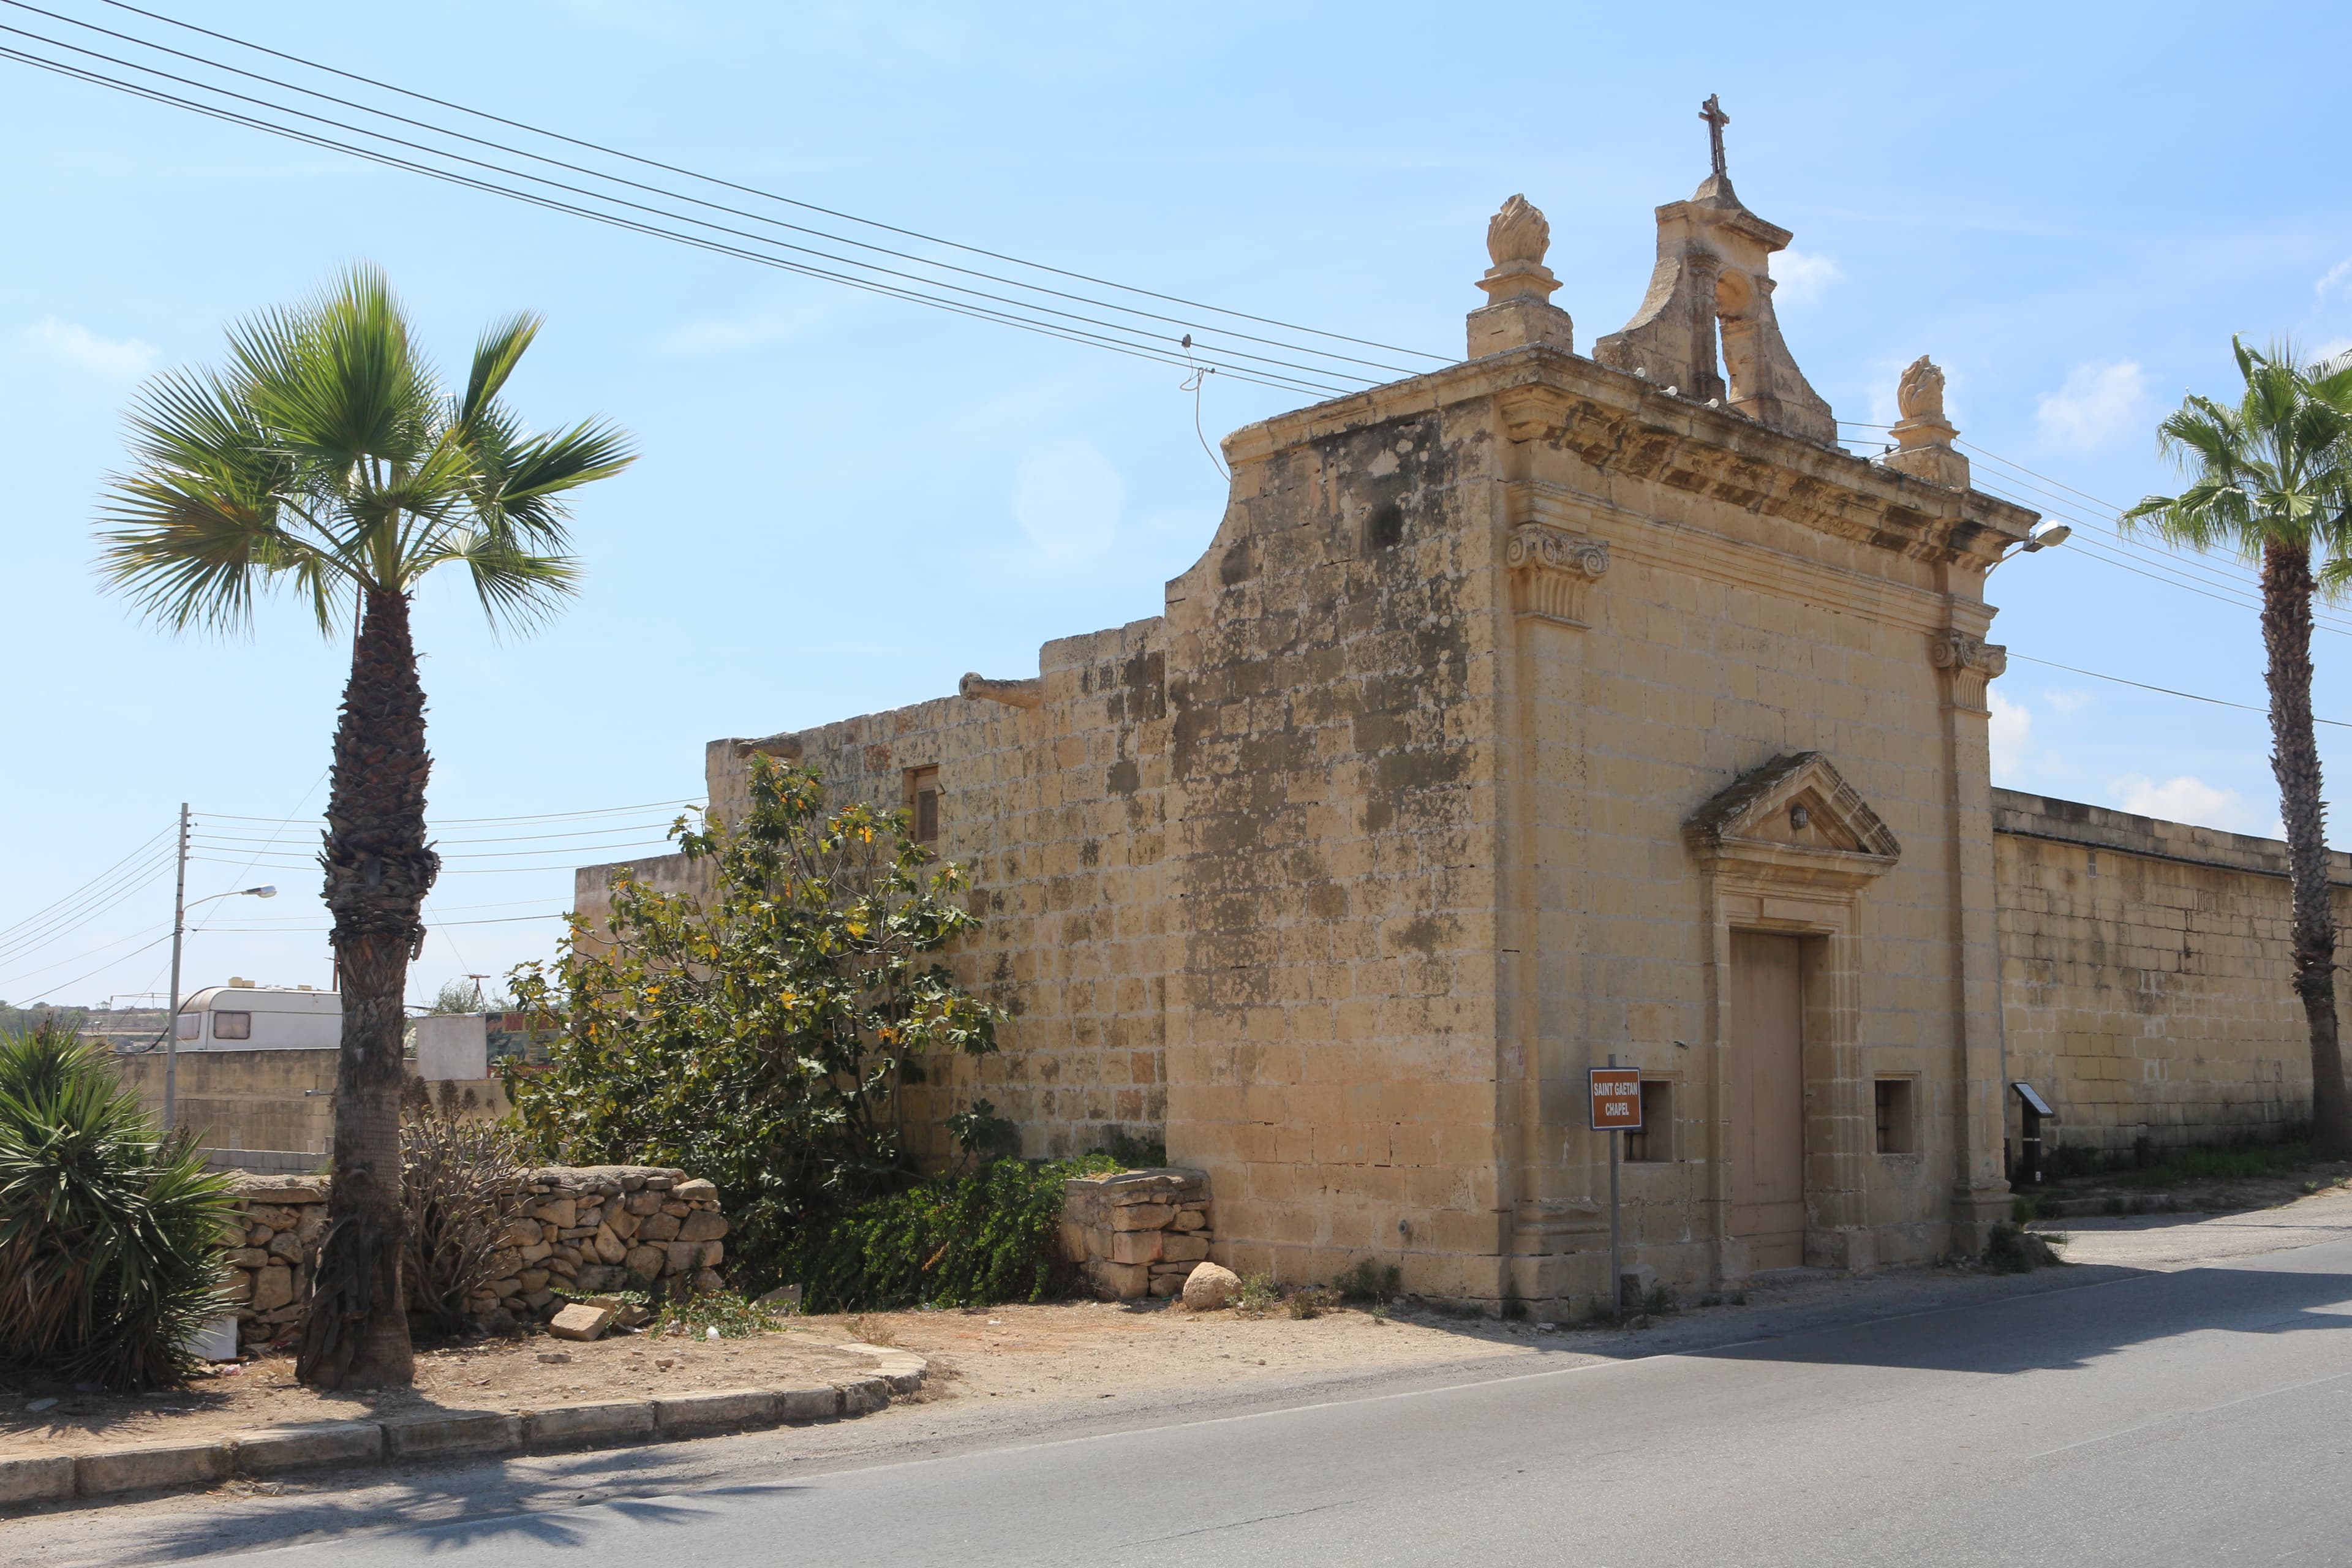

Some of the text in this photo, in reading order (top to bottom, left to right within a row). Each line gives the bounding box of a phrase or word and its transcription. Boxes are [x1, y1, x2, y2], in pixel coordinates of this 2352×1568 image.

[1594, 1082, 1637, 1096] SAINT GAETAN
[1605, 1102, 1629, 1116] CHAPEL
